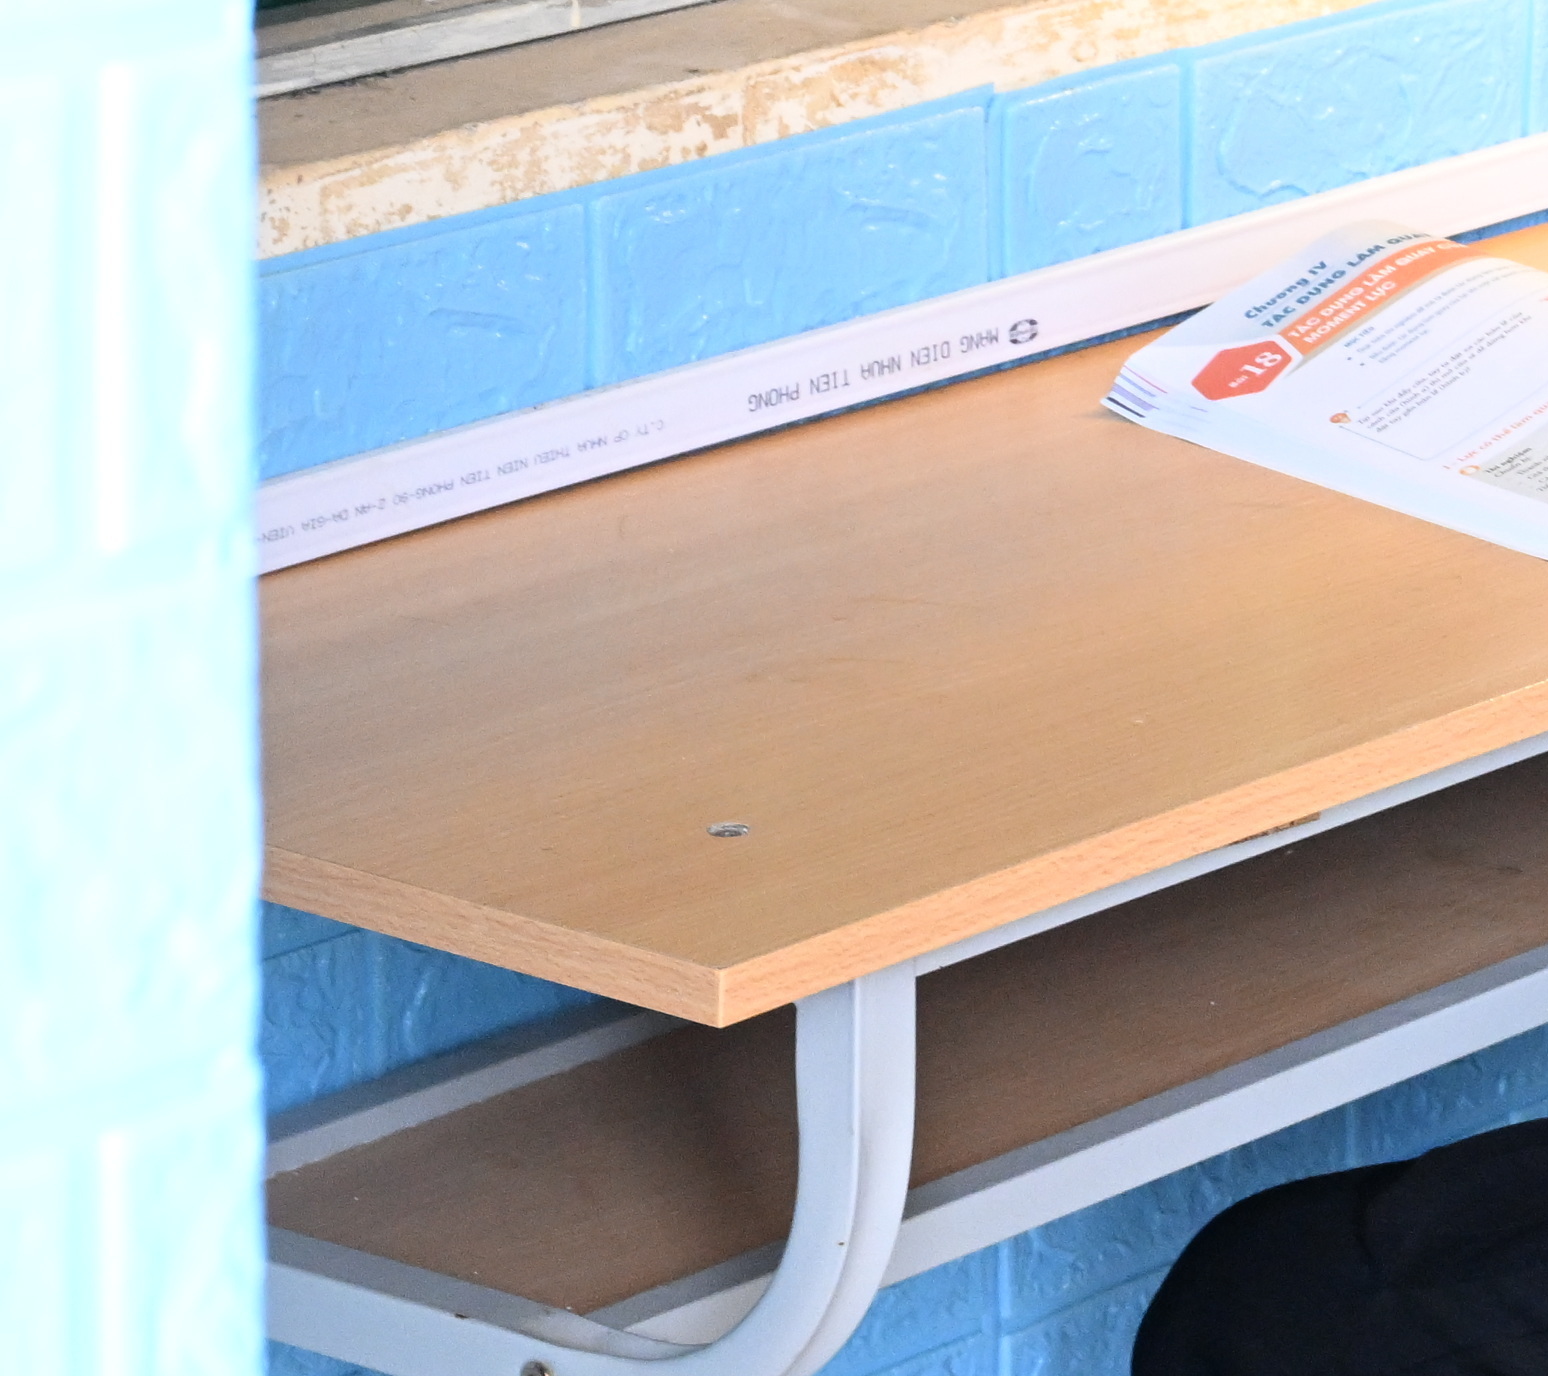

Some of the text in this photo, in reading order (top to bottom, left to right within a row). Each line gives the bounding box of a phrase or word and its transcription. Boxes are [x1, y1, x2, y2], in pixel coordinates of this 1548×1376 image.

[1309, 261, 1327, 276] IV
[1303, 300, 1366, 344] MOMENT
[748, 327, 999, 413] MANG DIEN NHUA TIEN PHONG
[1239, 352, 1282, 377] 18
